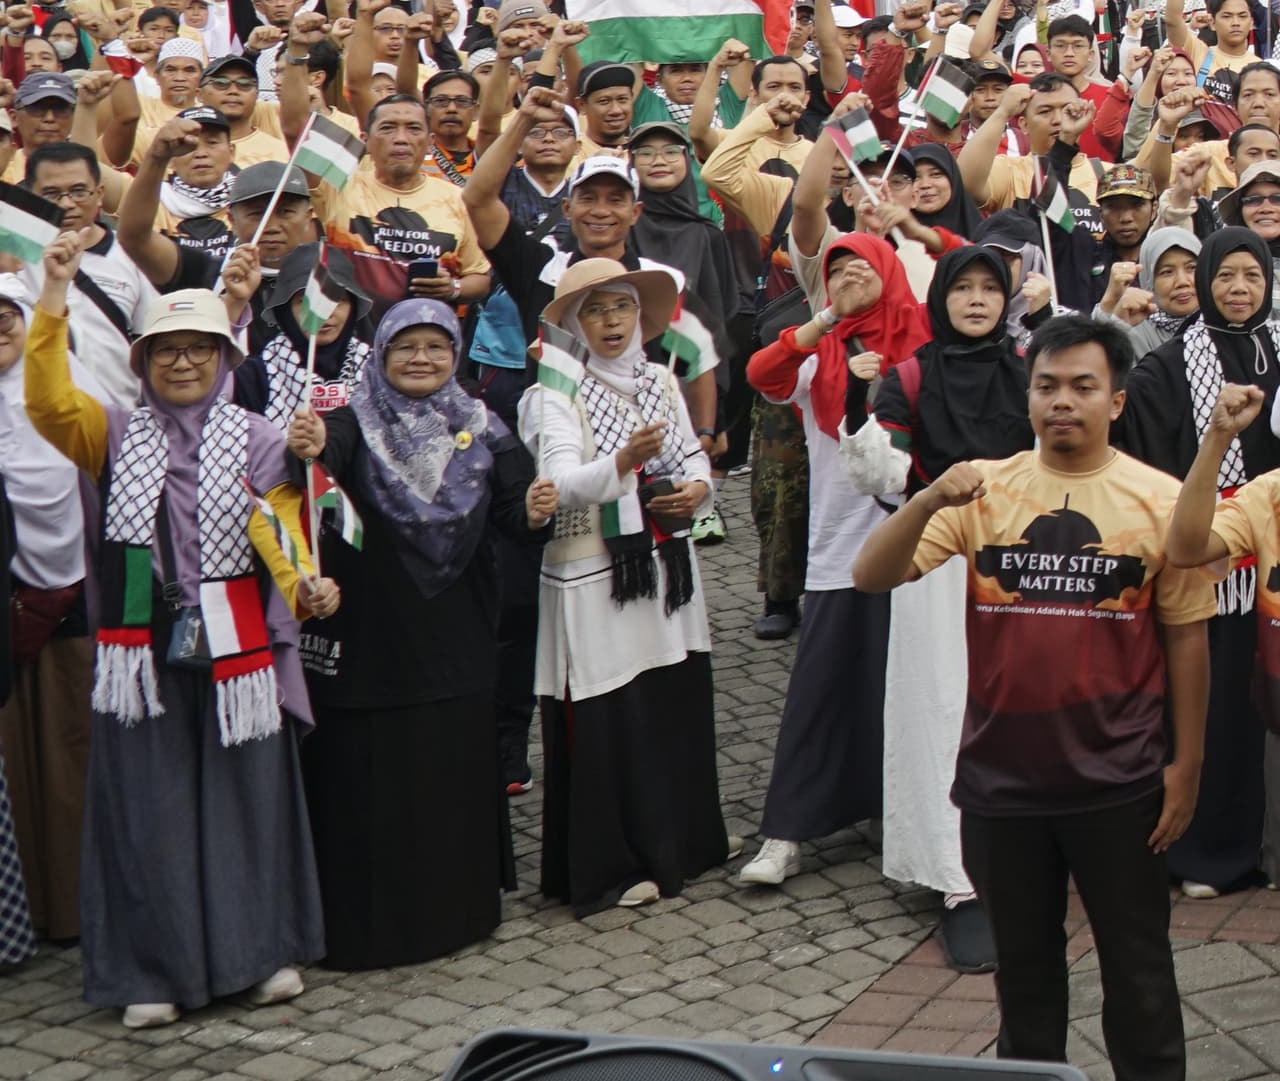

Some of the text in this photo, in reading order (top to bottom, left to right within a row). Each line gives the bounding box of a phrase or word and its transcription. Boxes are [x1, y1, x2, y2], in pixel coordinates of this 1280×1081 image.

[207, 234, 229, 246] FOR
[378, 227, 431, 241] RUN FOR
[1001, 552, 1119, 575] EVERY STEP
[1018, 575, 1097, 593] MATTERS
[1036, 607, 1066, 617] Adalah
[1068, 608, 1086, 618] Hak
